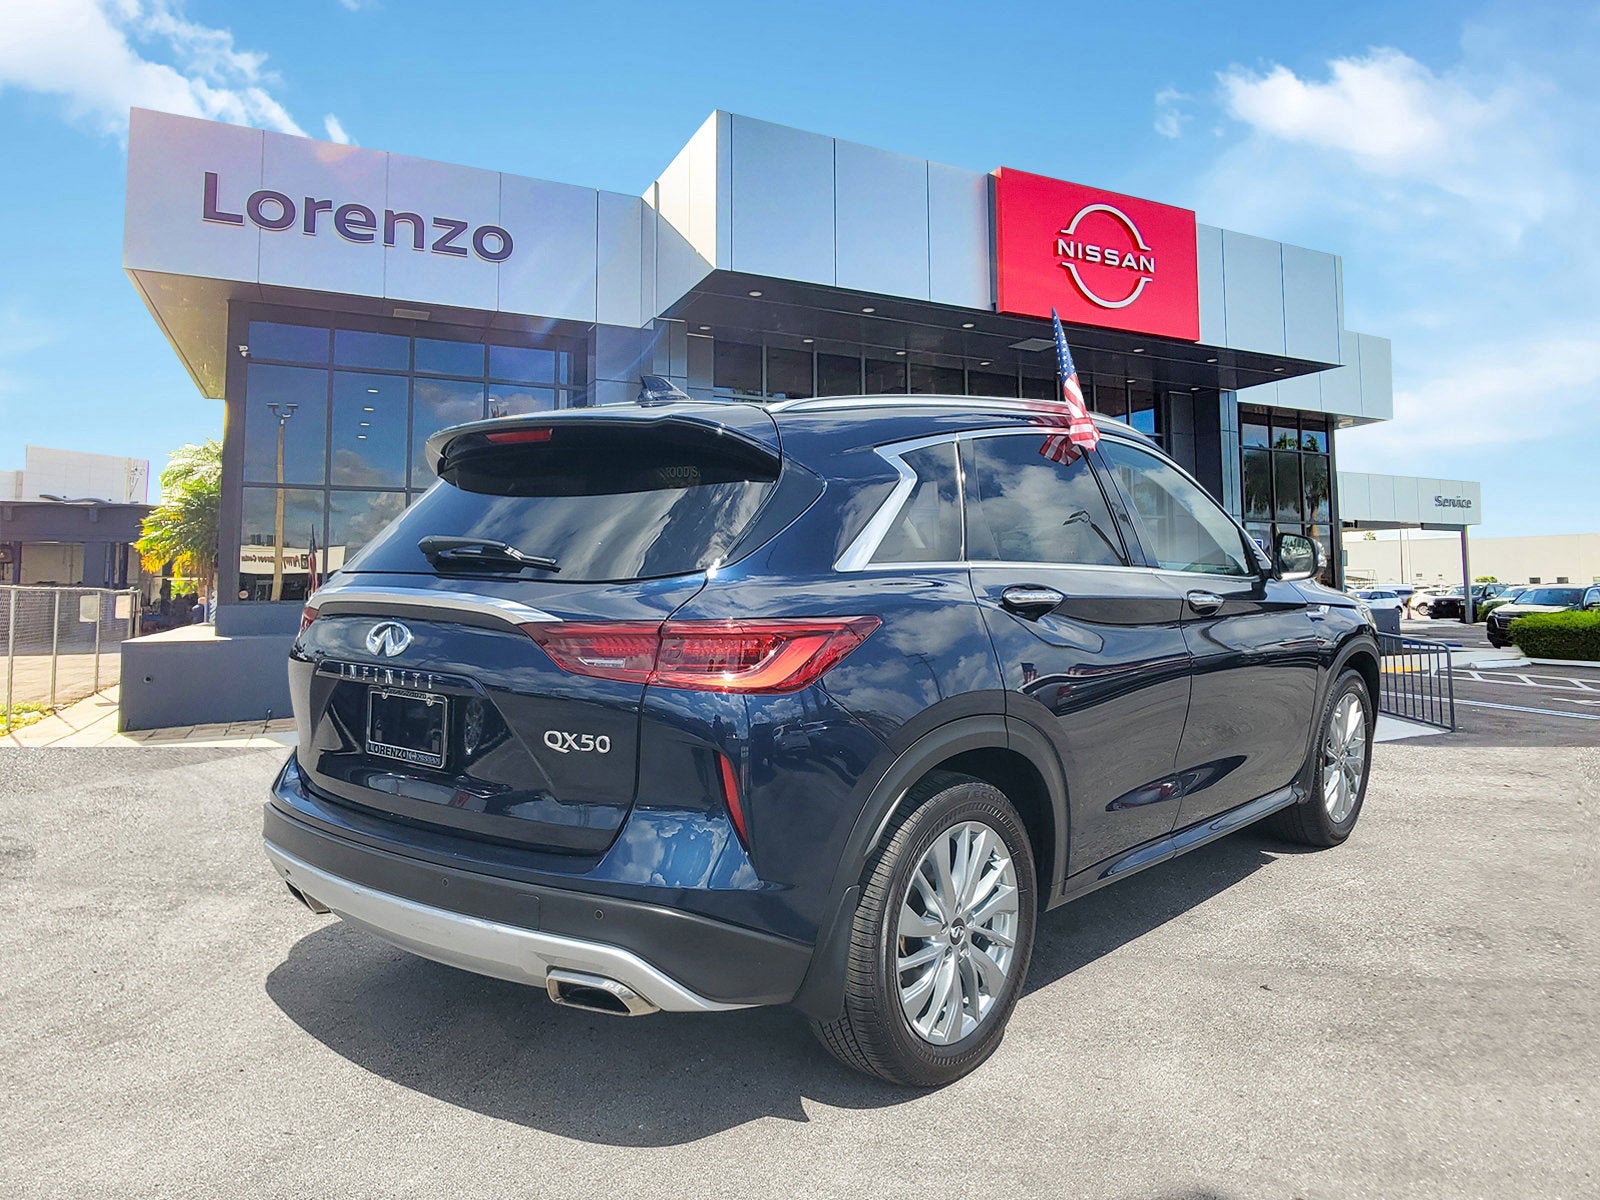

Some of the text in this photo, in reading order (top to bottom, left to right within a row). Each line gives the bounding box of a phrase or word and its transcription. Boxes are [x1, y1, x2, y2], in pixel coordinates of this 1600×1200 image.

[202, 171, 514, 262] Lorenzo
[1057, 238, 1155, 273] NISSAN
[1434, 495, 1472, 509] Service
[340, 663, 433, 689] INFINITI
[367, 742, 408, 759] LORENZO
[543, 729, 611, 754] QX50
